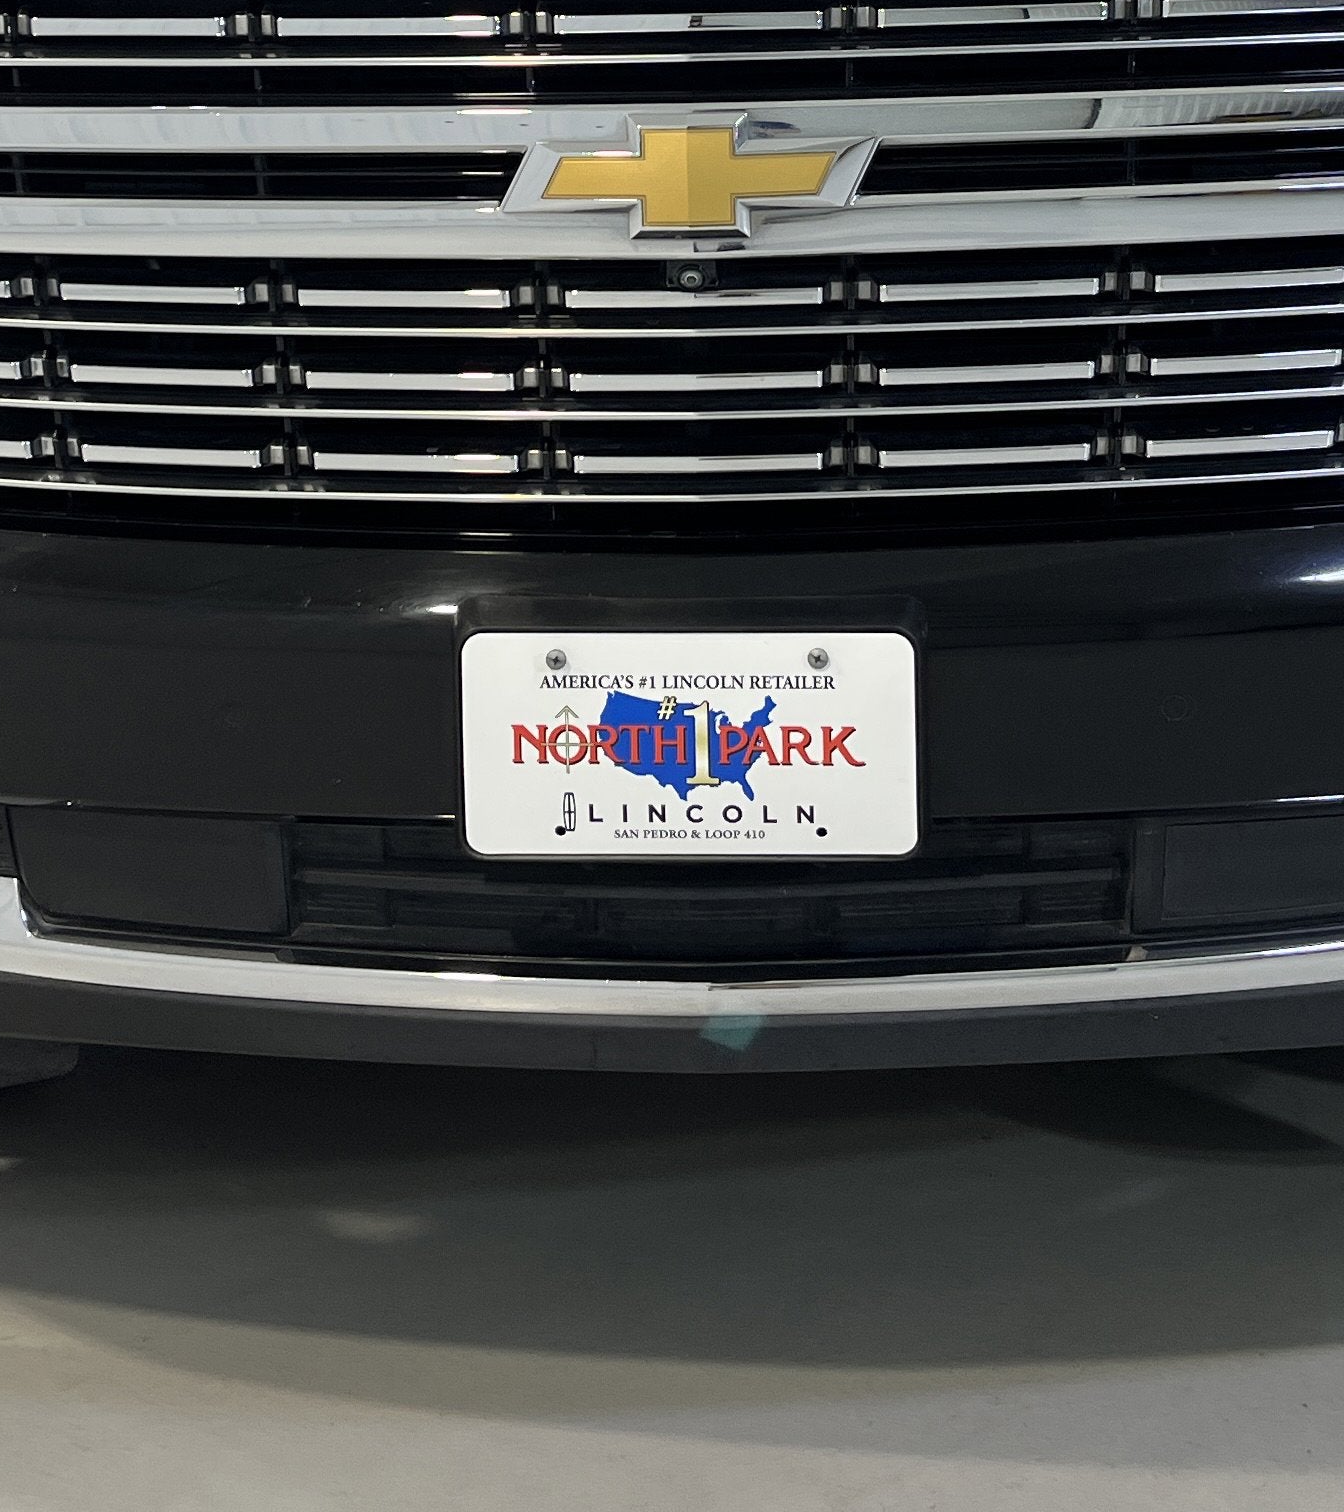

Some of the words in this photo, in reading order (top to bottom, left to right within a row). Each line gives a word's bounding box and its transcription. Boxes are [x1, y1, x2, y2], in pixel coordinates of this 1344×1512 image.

[540, 674, 634, 689] AMERICA'S
[638, 675, 656, 689] #1
[662, 675, 744, 689] LINCOLN
[750, 675, 836, 690] RETAILER
[511, 724, 687, 765] NORTH
[719, 725, 867, 767] PARK
[588, 804, 815, 824] LINCOLN
[613, 829, 639, 839] SAN
[643, 829, 688, 839] PEDRO
[690, 829, 701, 839] &
[705, 830, 741, 839] LOOP
[744, 830, 766, 839] 410
